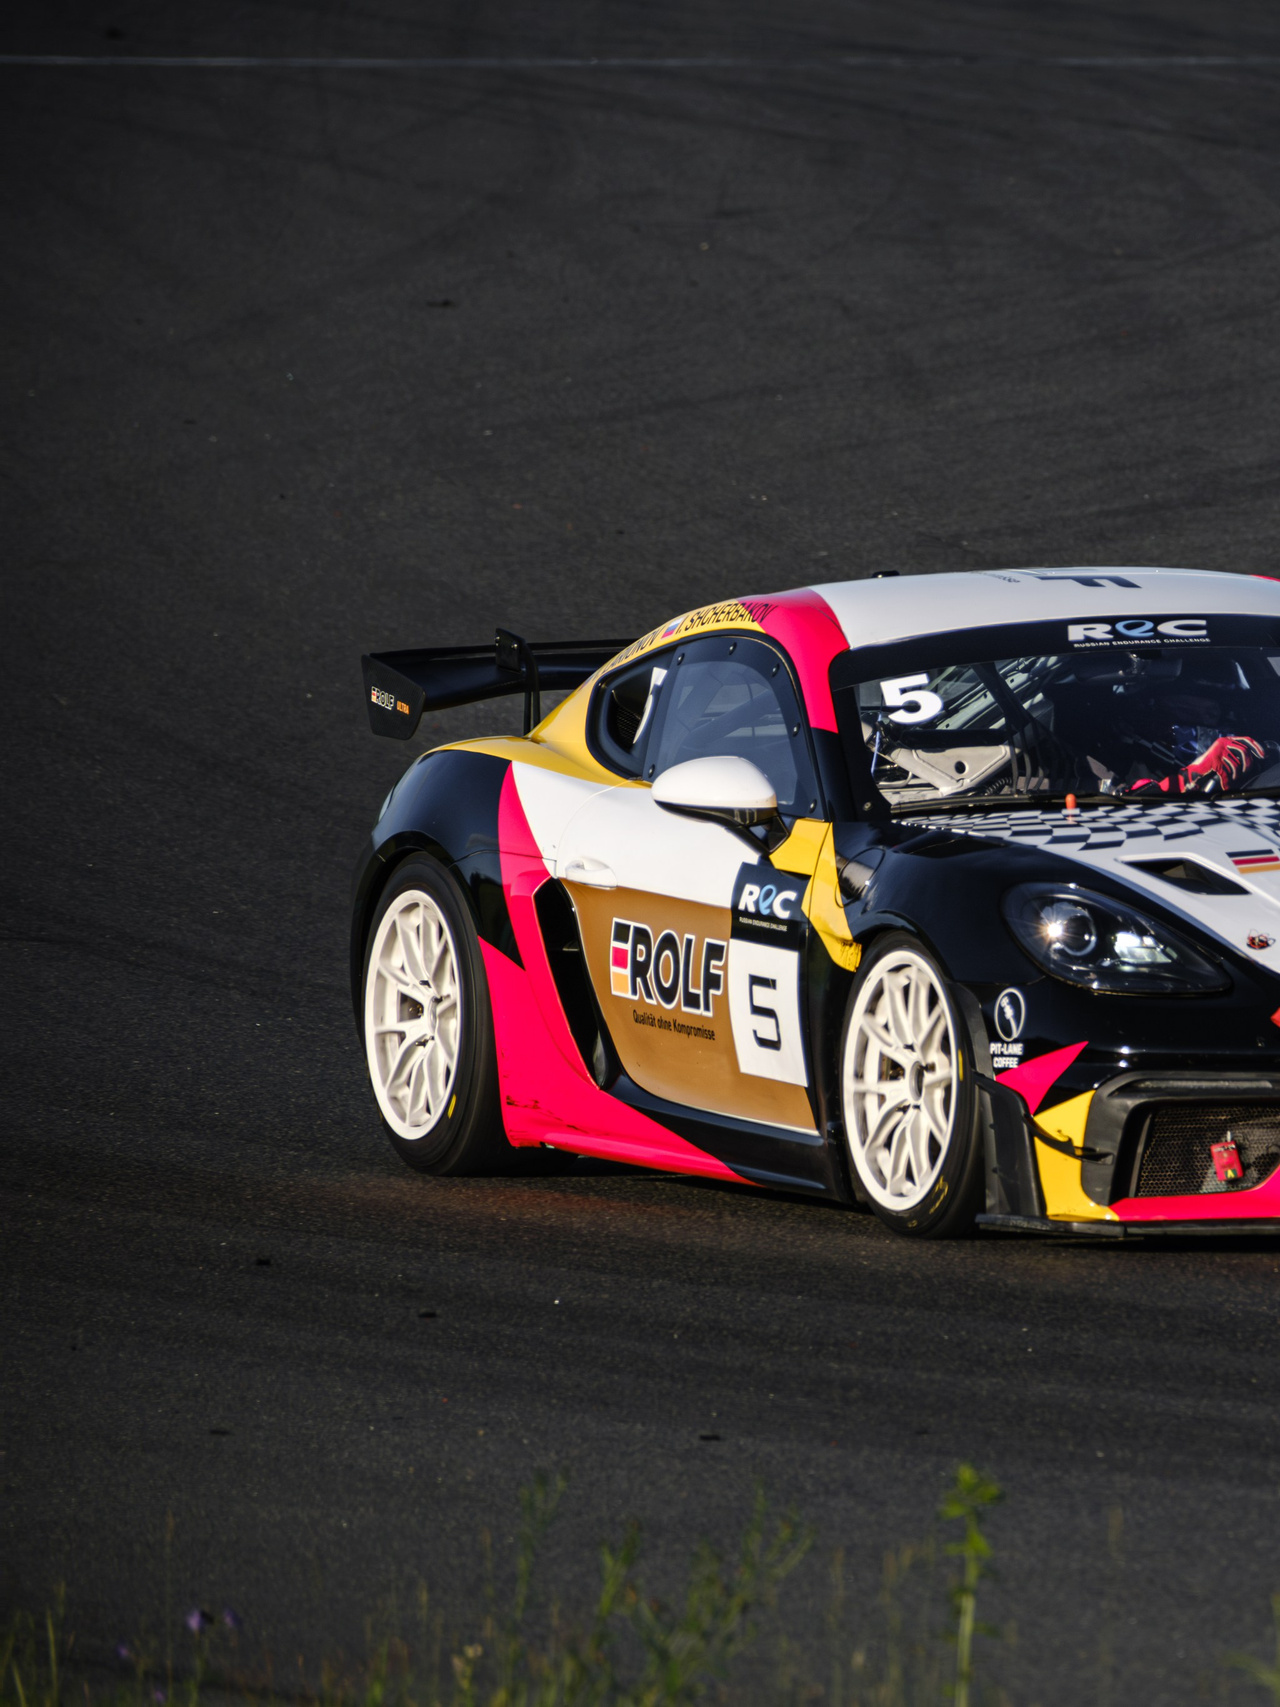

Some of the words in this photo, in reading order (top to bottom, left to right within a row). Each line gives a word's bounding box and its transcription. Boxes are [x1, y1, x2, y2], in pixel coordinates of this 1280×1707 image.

[685, 602, 779, 631] SHCHERBAKOV
[376, 687, 395, 710] ROLF
[880, 673, 943, 724] 5
[630, 922, 728, 1018] ROLF
[633, 1009, 656, 1028] Qualität
[657, 1016, 672, 1031] ohne
[673, 1018, 716, 1041] Kompromisse
[748, 973, 782, 1052] 5
[989, 1042, 1024, 1056] PIT-LANE
[993, 1056, 1019, 1069] COFFEE
